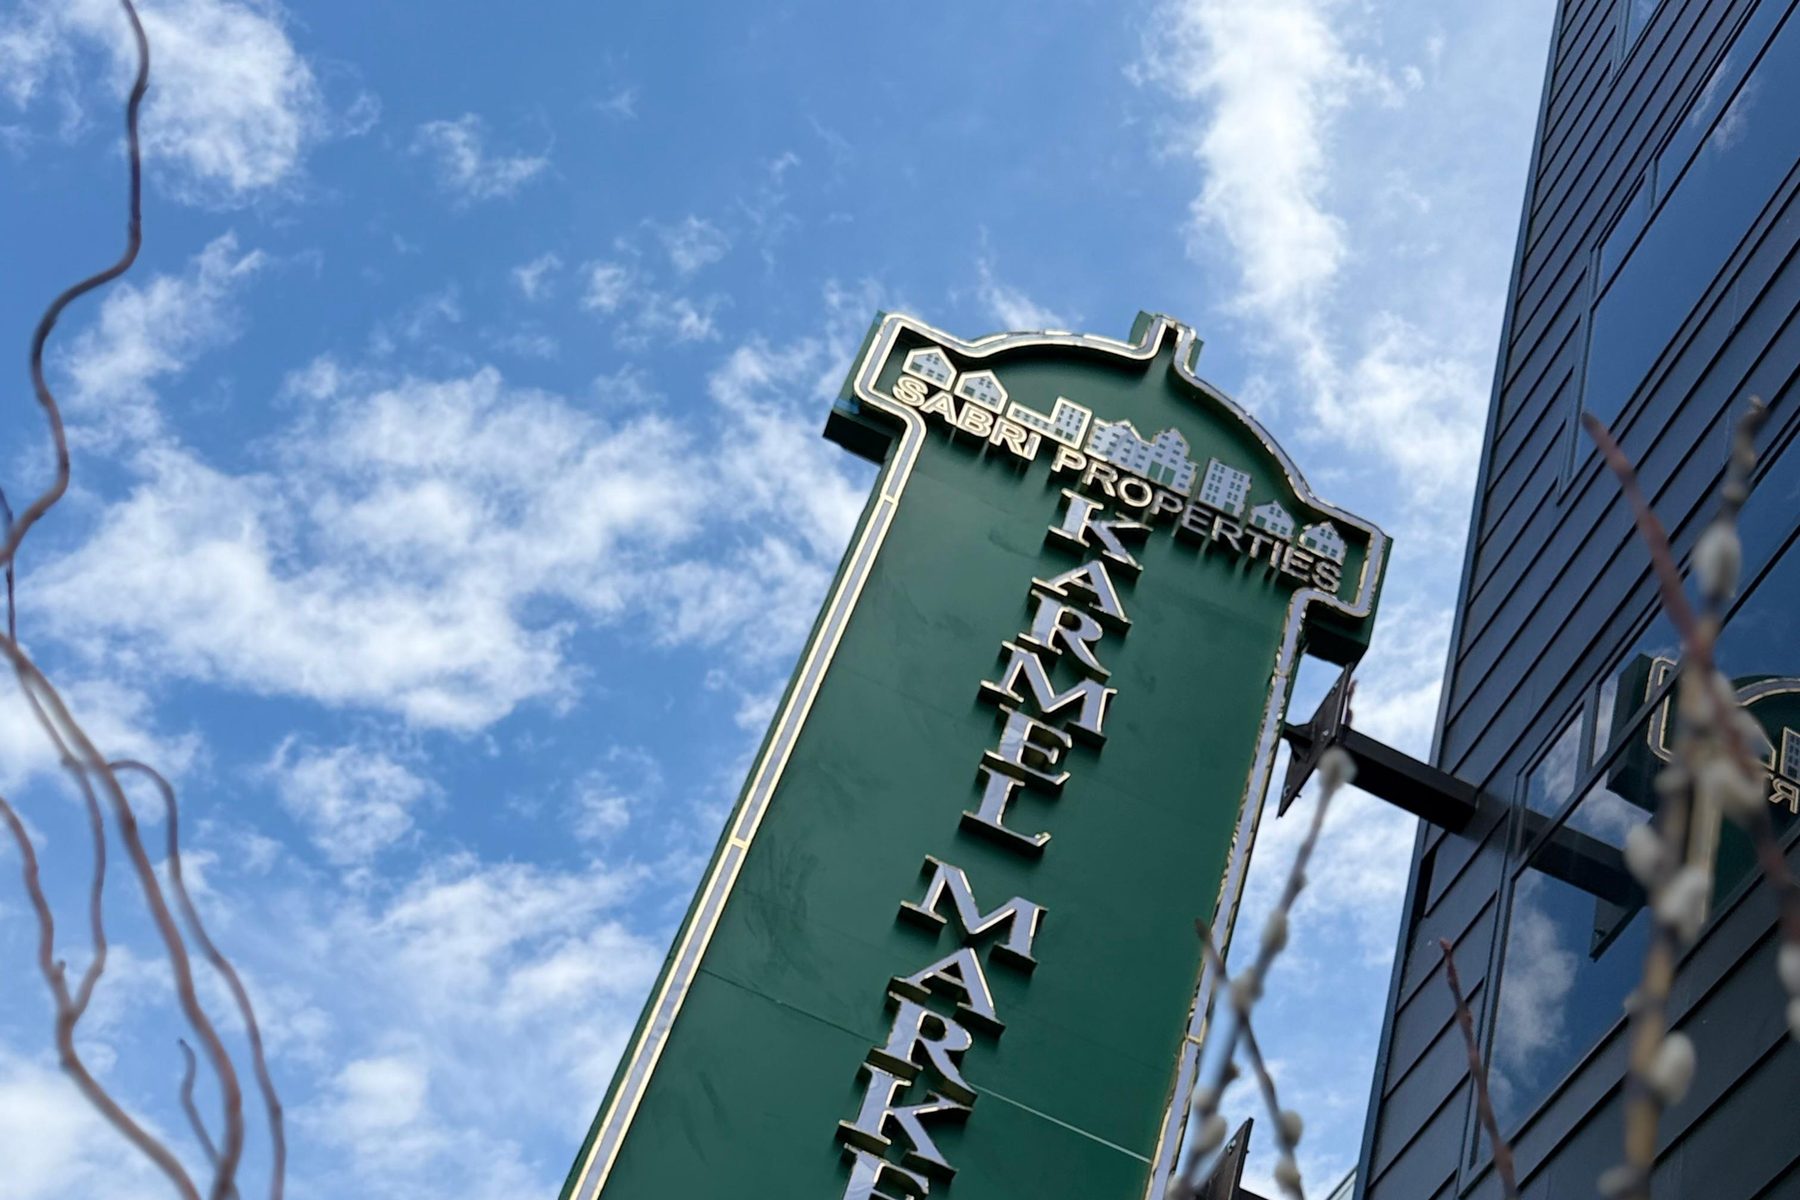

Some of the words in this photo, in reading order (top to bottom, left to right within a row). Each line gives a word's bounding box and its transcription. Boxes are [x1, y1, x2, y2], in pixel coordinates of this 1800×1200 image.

[892, 375, 1041, 462] SABRI
[1050, 445, 1342, 593] PROPERTIES
[962, 487, 1153, 850] KARMEL
